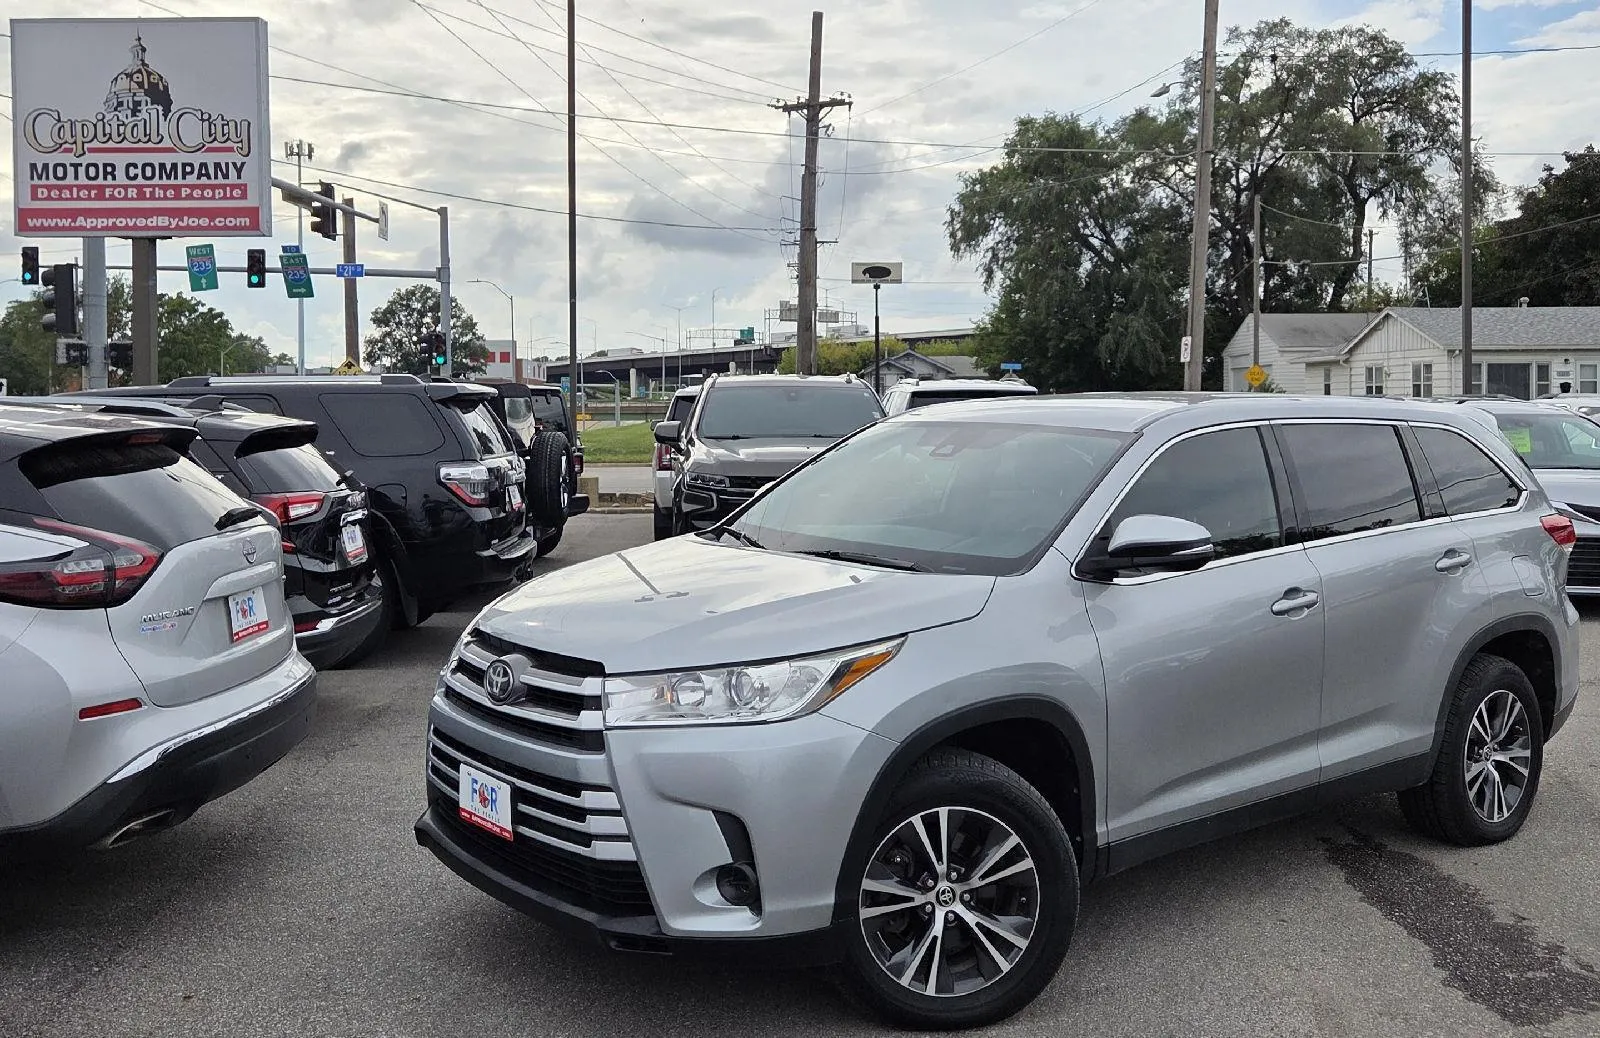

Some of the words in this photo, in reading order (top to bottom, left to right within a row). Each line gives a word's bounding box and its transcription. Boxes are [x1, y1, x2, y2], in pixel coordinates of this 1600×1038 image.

[24, 107, 164, 157] Capital
[168, 107, 251, 157] City
[29, 162, 117, 181] MOTOR
[125, 161, 246, 181] COMPANY
[37, 188, 98, 199] Dealer
[105, 188, 138, 199] FOR
[143, 188, 175, 198] The
[181, 187, 242, 198] People
[27, 215, 250, 230] www.ApprovedByJoe.com
[189, 247, 212, 256] WEST
[282, 256, 304, 264] EAST
[192, 261, 212, 272] 235
[287, 270, 306, 279] 235
[141, 606, 195, 623] MURANO
